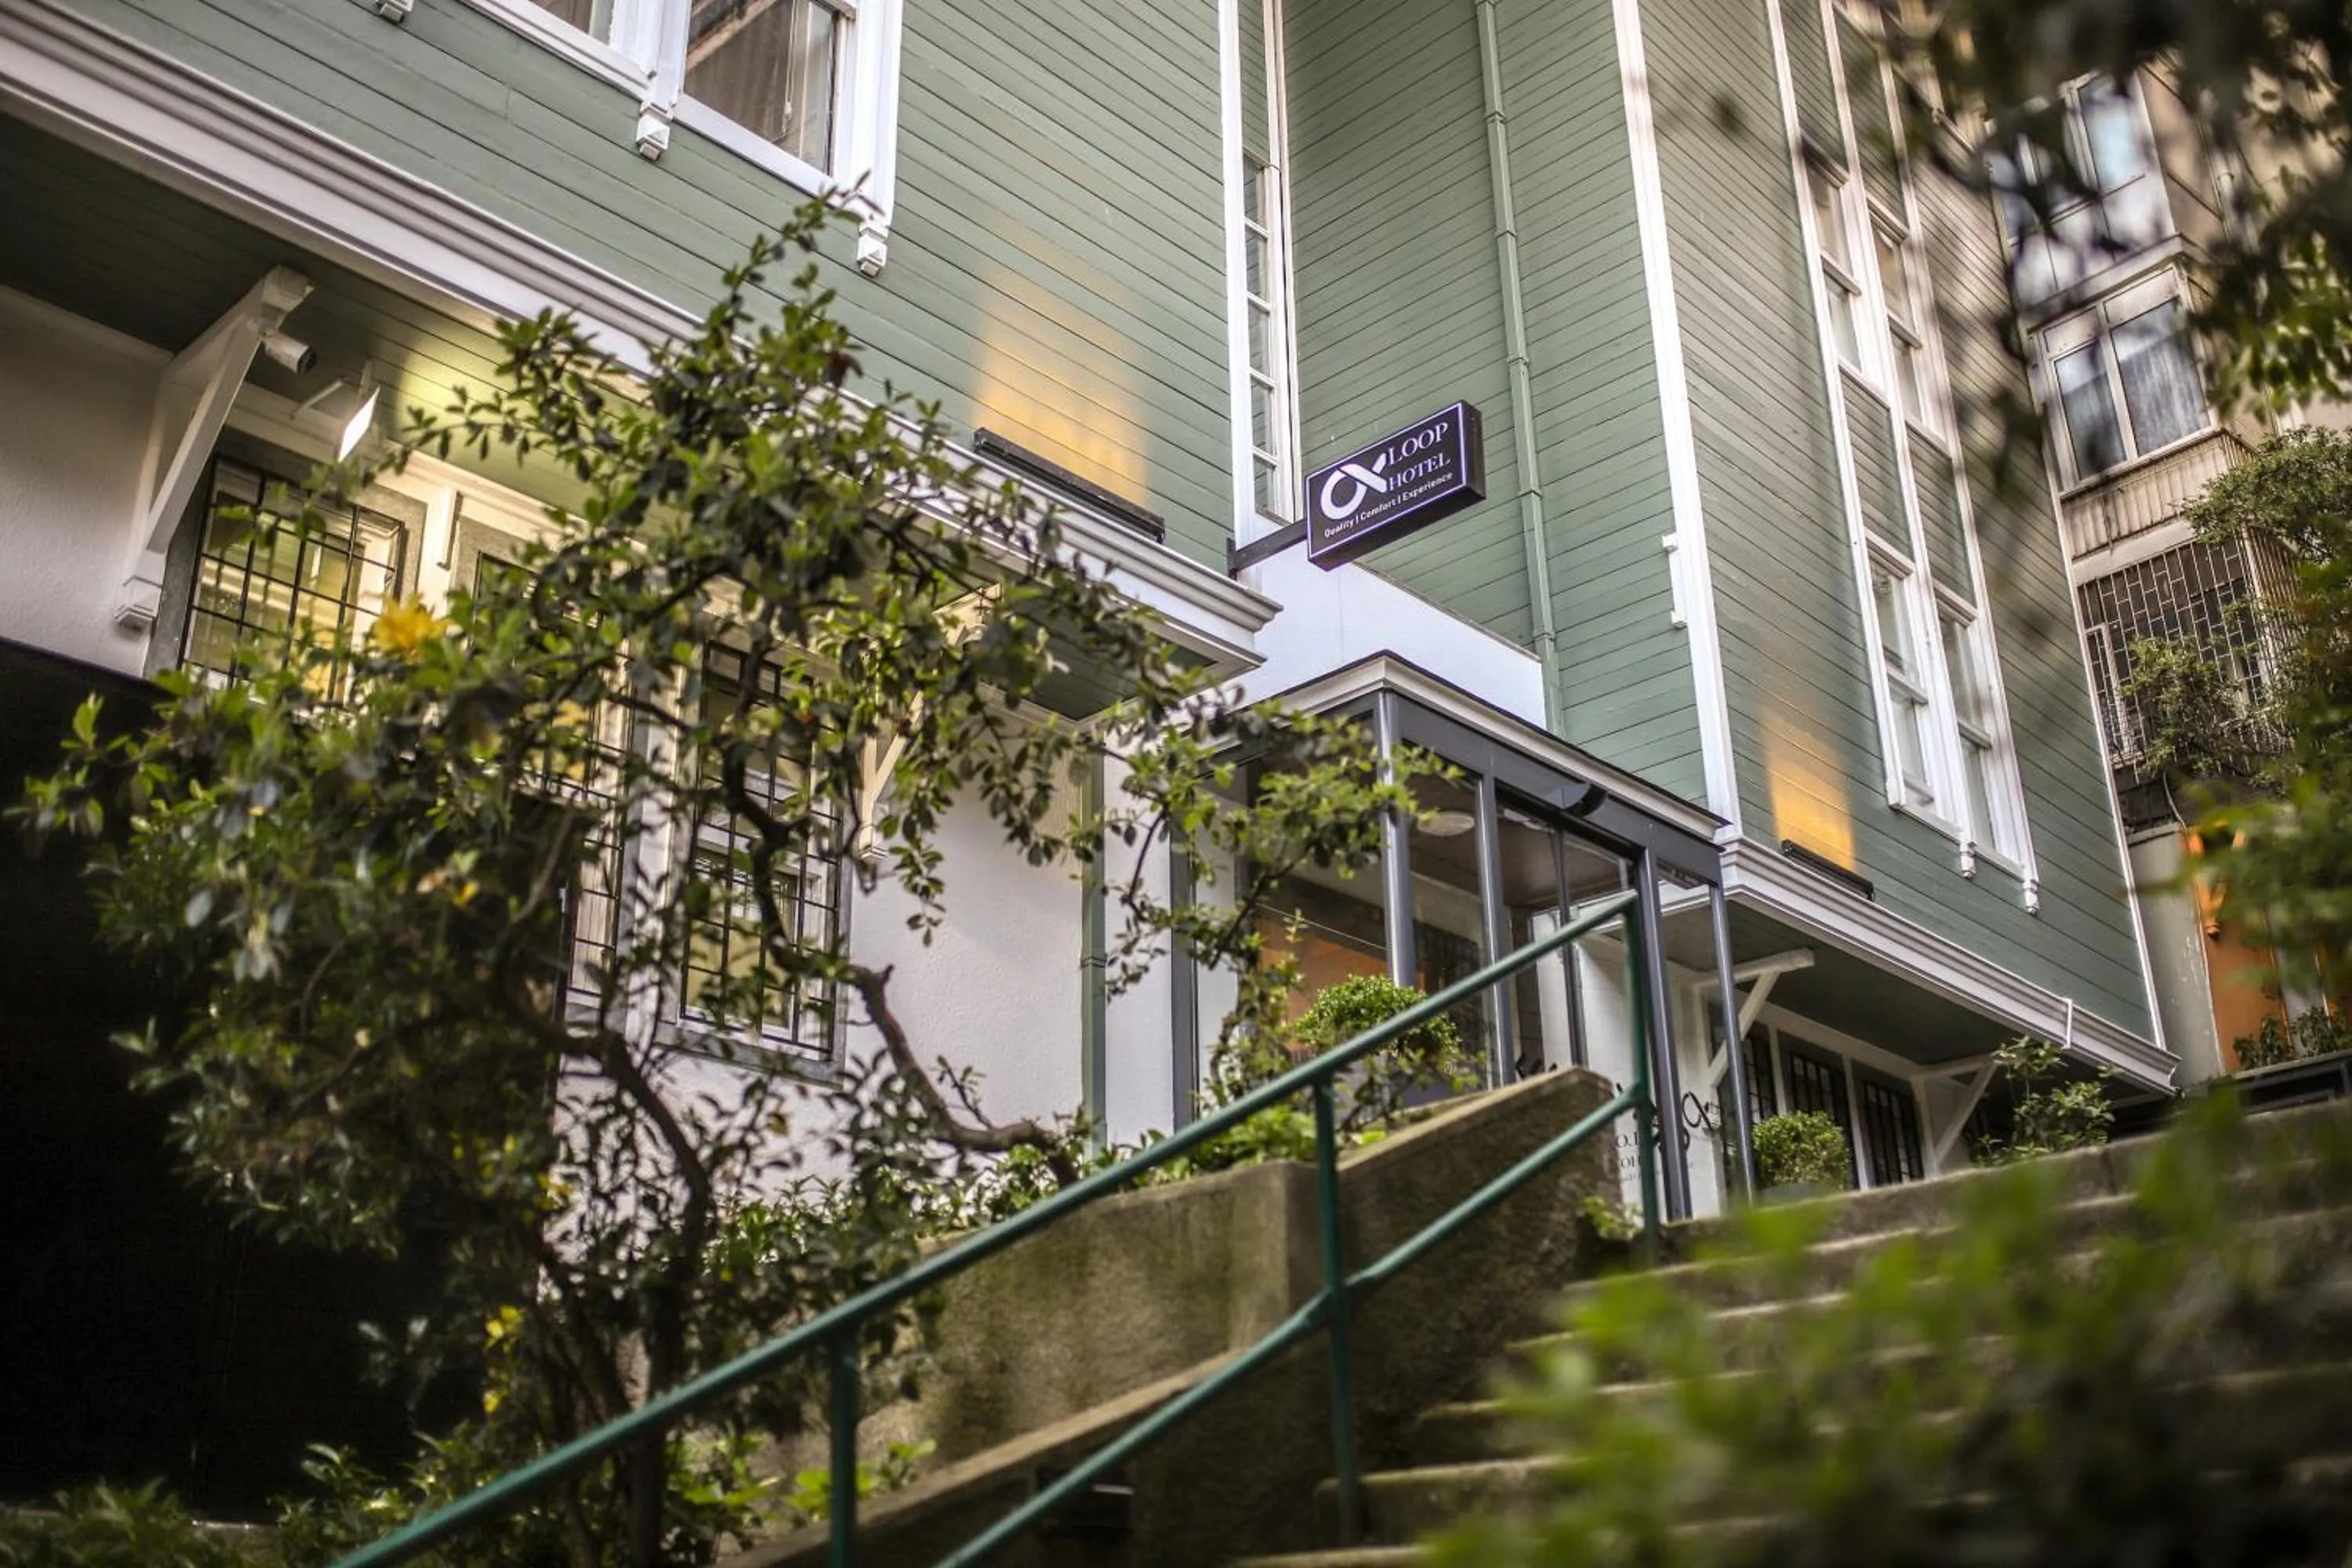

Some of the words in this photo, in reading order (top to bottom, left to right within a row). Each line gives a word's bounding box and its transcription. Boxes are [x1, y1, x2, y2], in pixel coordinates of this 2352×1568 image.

[1388, 422, 1448, 465] LOOP
[1389, 452, 1450, 492] HOTEL
[1324, 519, 1354, 538] Quality
[1360, 498, 1396, 521] Comfort
[1403, 473, 1453, 501] Experience
